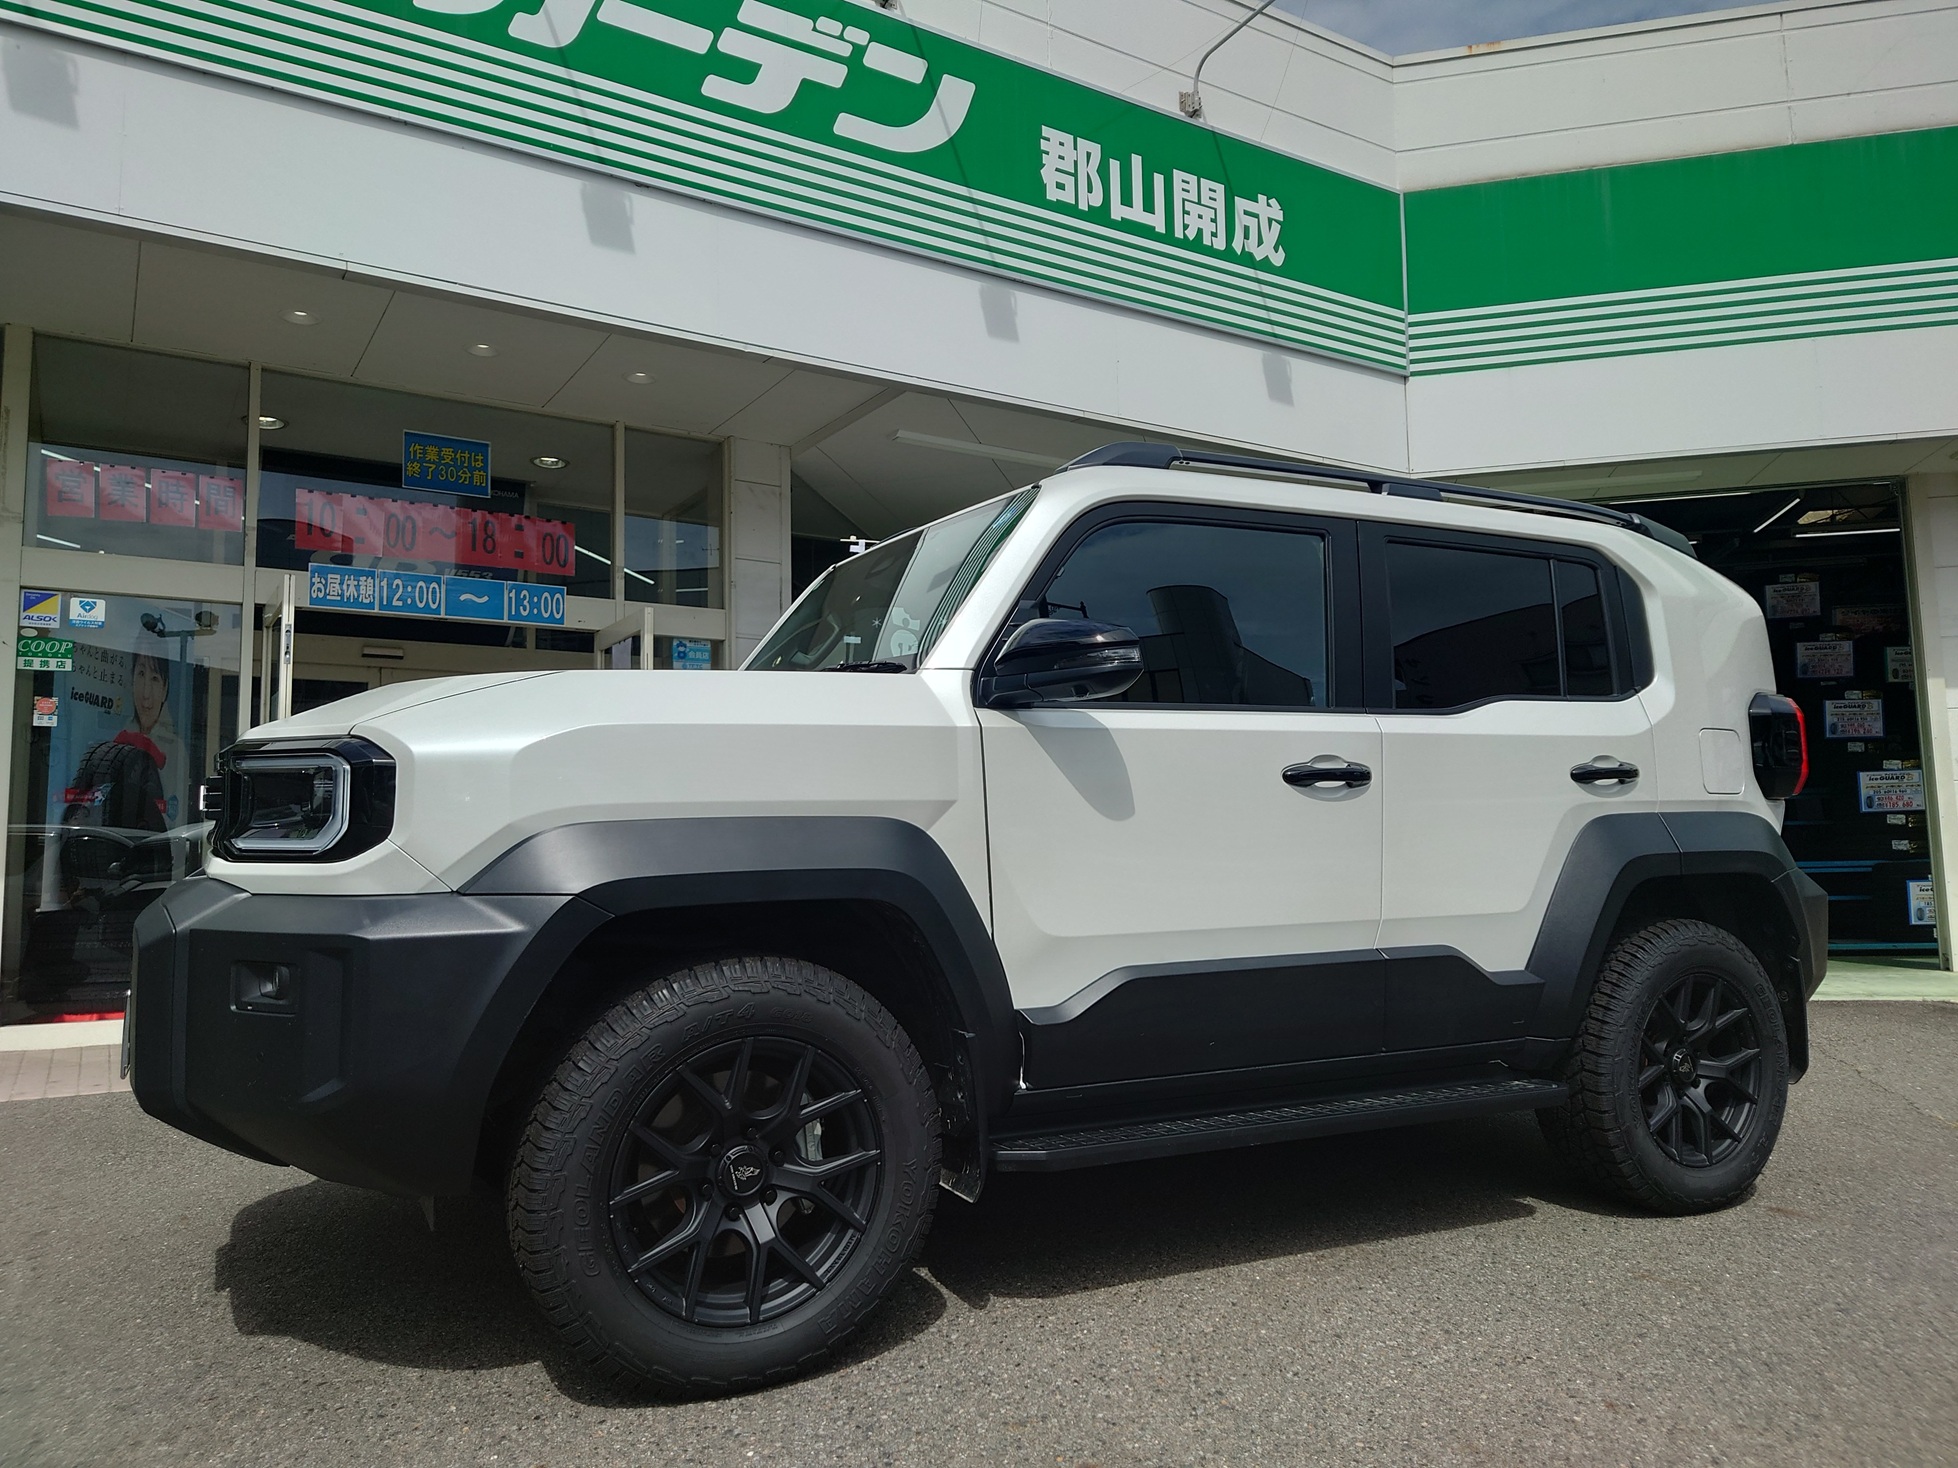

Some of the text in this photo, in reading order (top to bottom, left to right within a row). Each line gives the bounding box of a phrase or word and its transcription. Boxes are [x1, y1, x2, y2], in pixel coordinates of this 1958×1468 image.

[1040, 124, 1286, 267] 郡山開成
[409, 443, 484, 467] 作業受付は
[406, 461, 487, 486] 終了30分前
[55, 469, 236, 519] 営業時間
[311, 572, 374, 604] お昼休憩
[380, 578, 441, 609] 12:00
[509, 589, 564, 619] 13:00
[23, 614, 57, 623] ALSOK
[18, 640, 72, 653] COOP
[24, 659, 66, 669] 提携店
[70, 687, 114, 710] iceGUARD
[574, 1043, 666, 1278] GEOLANDAR
[817, 1158, 918, 1335] YOKOHAMA
